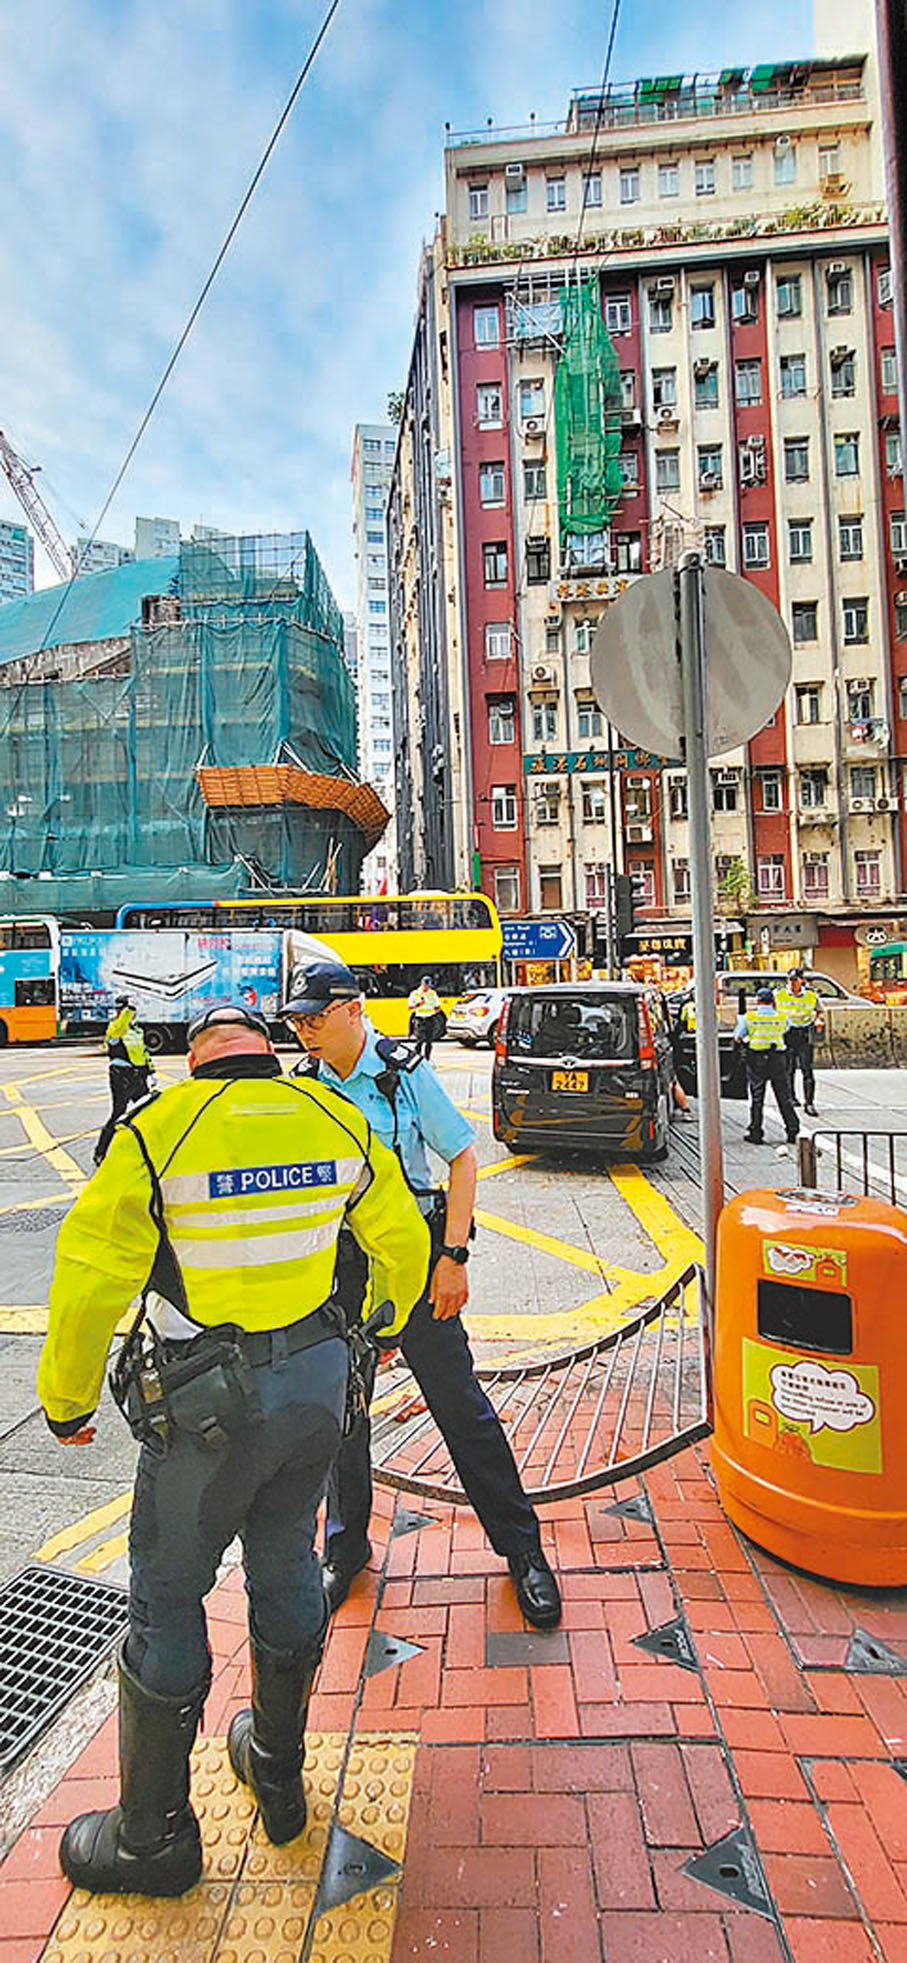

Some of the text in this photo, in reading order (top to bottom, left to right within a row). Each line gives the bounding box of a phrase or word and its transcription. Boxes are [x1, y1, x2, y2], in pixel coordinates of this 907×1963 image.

[216, 1165, 333, 1195] 警 POLICE 察
